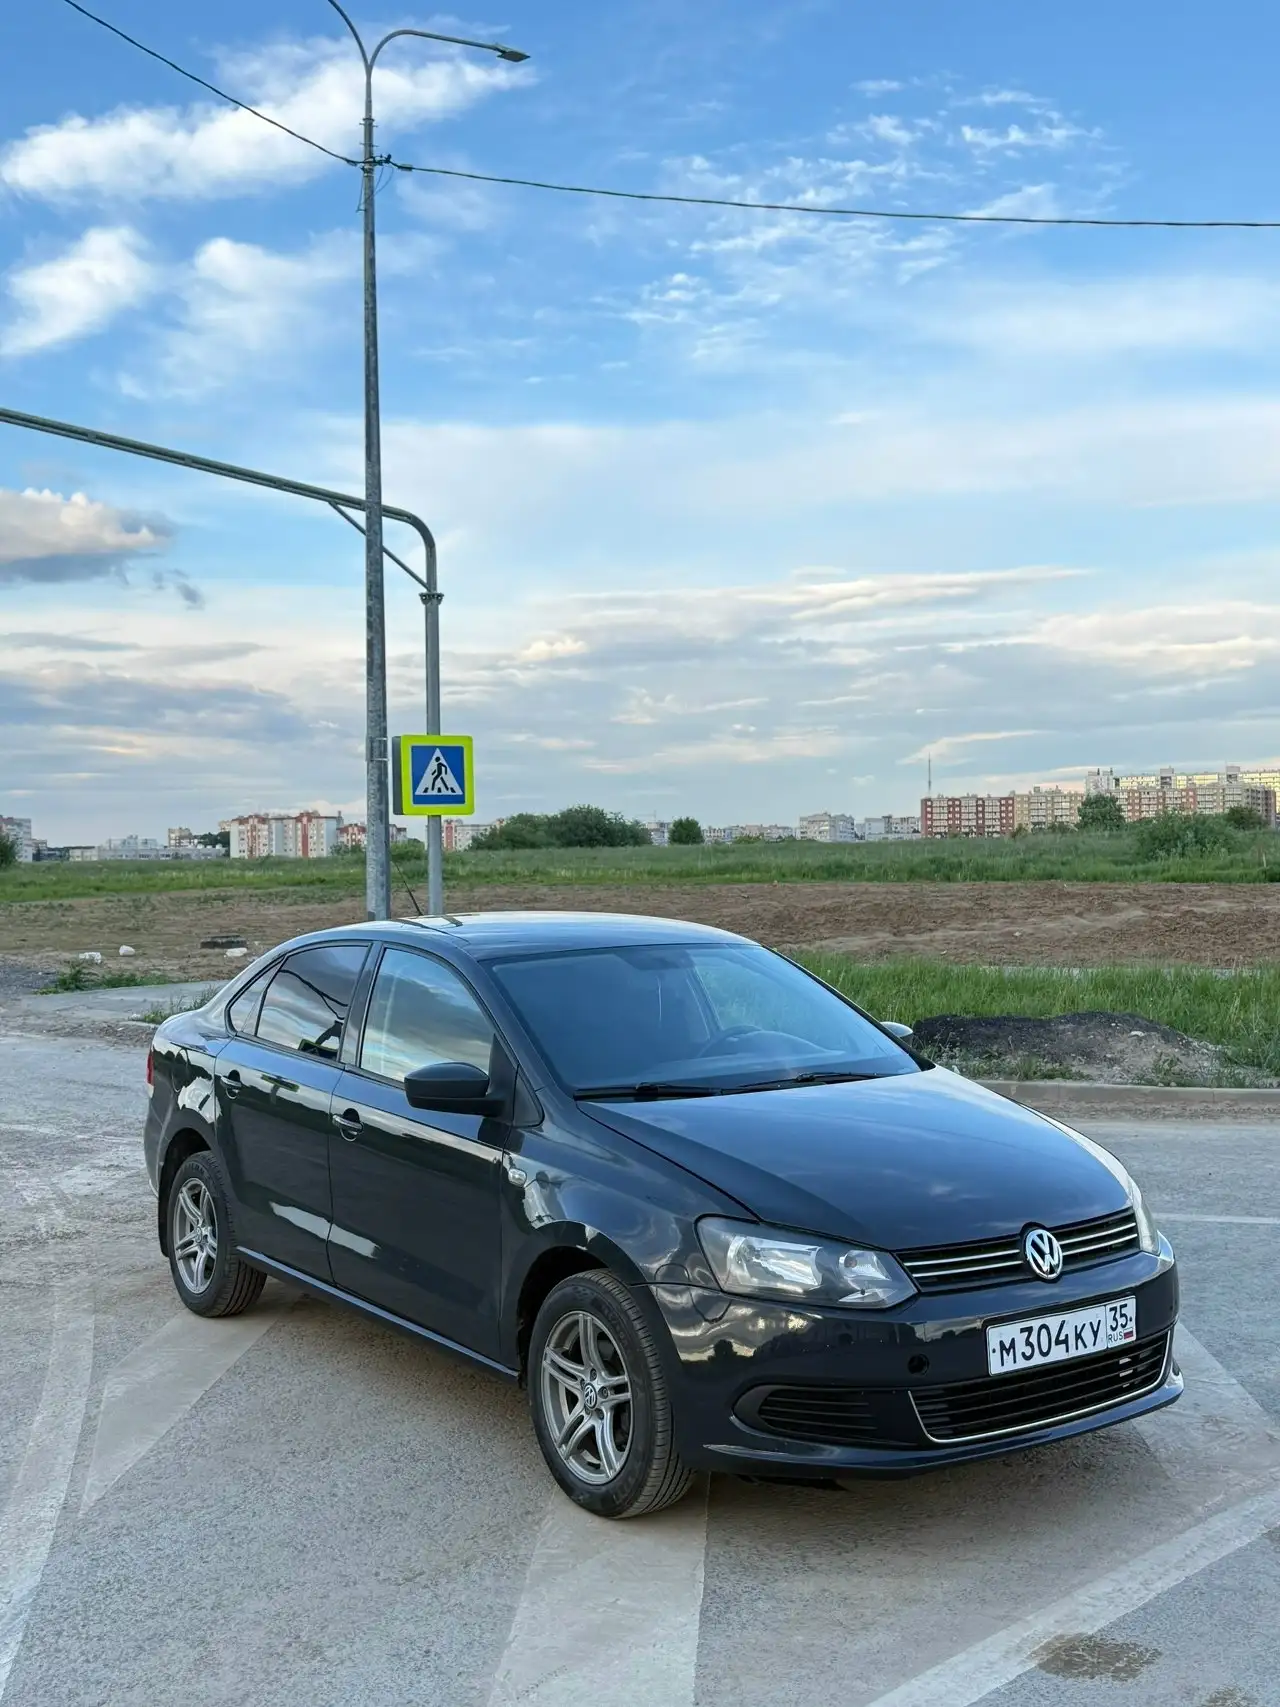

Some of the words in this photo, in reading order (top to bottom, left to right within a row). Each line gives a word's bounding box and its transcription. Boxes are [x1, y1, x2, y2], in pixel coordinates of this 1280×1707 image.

[1028, 1231, 1062, 1277] VW
[998, 1319, 1101, 1367] М304КУ
[1109, 1303, 1128, 1332] 35
[1107, 1331, 1123, 1343] RUS
